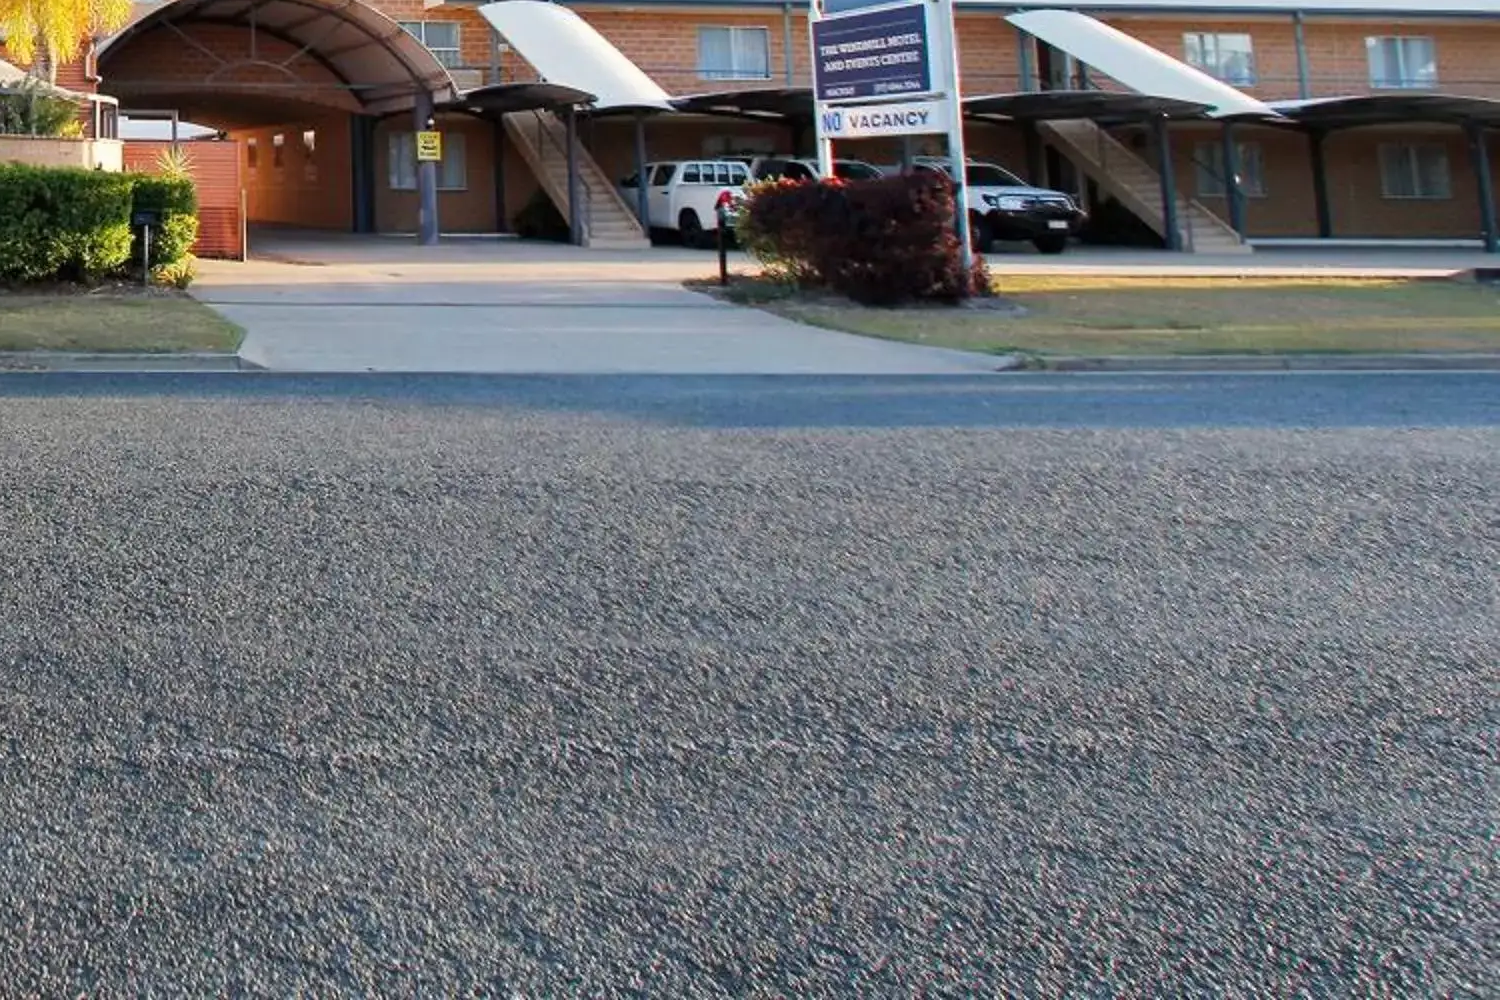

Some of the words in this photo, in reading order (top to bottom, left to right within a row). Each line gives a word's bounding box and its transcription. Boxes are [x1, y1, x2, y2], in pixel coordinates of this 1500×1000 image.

[887, 32, 921, 47] MOTEL
[824, 60, 844, 73] AND
[845, 56, 881, 70] EVENTS
[881, 50, 920, 65] CENTRE
[822, 112, 841, 132] NO
[849, 111, 929, 129] VACANCY
